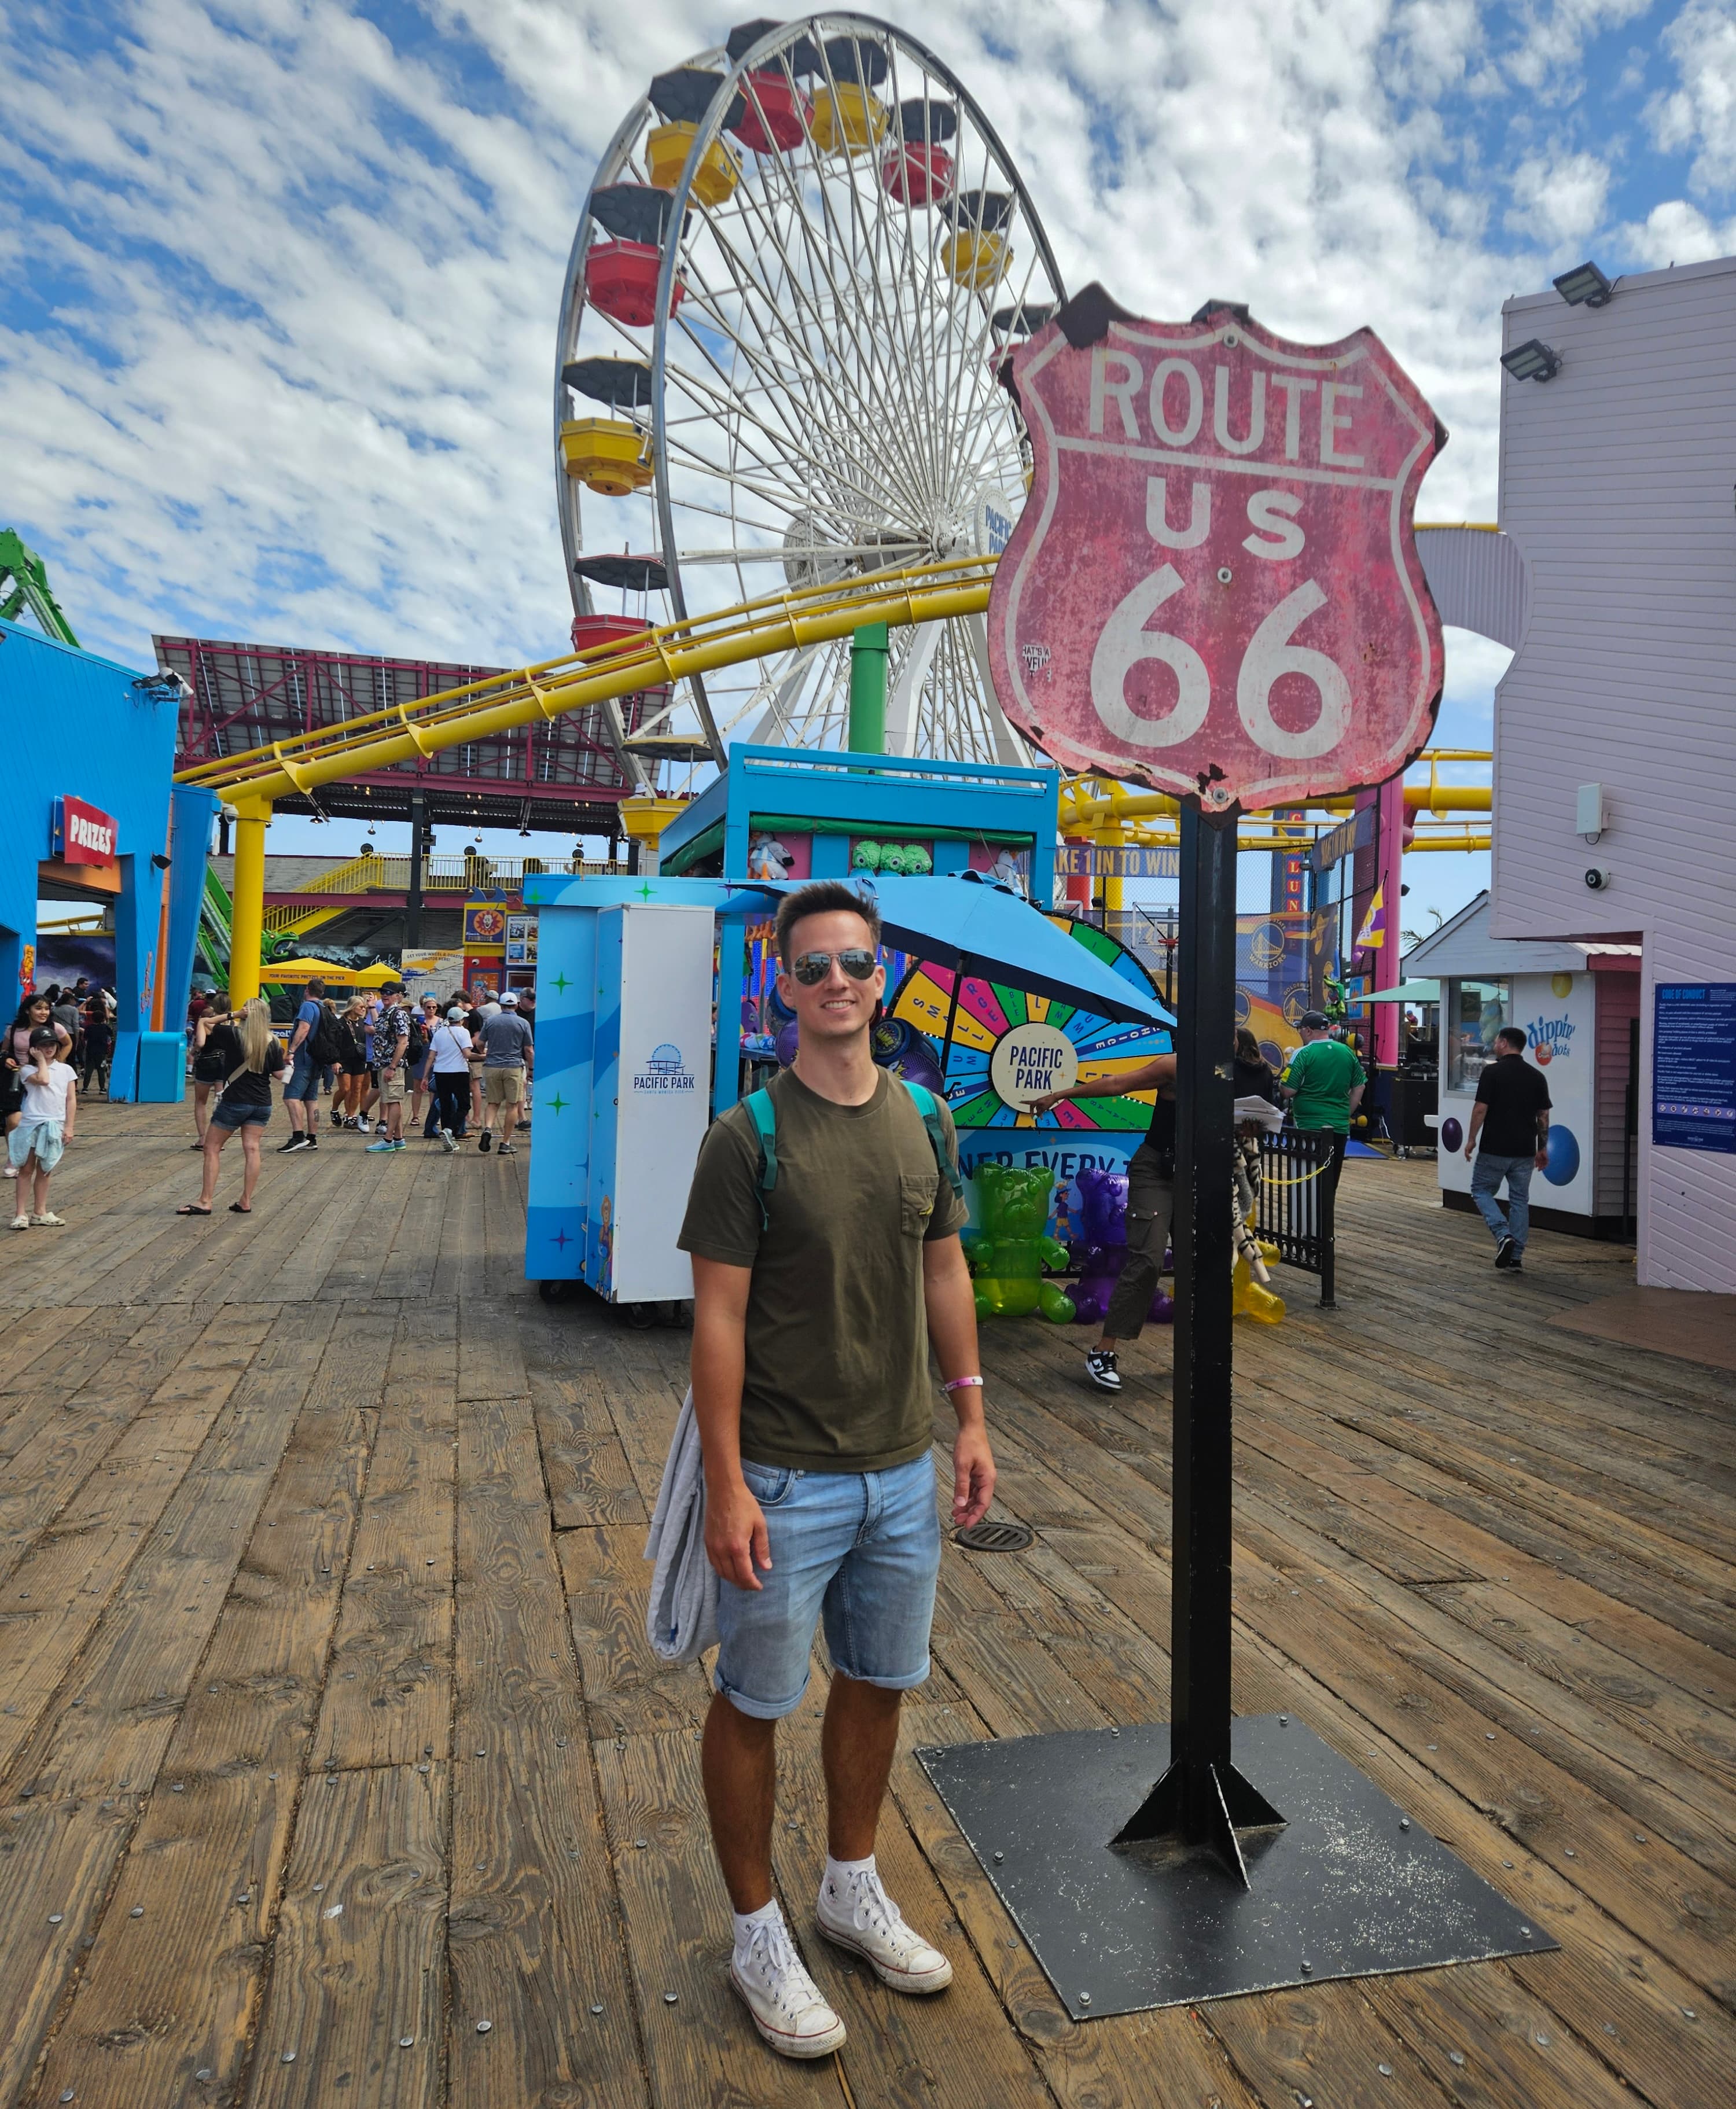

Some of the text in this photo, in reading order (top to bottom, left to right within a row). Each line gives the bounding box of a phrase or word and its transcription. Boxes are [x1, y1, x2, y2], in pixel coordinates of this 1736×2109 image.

[1089, 345, 1366, 469] ROUTE
[985, 504, 1012, 541] PACIFIC
[989, 532, 1006, 554] PAR
[1090, 562, 1352, 760] 66
[70, 814, 112, 855] PRIZES
[1084, 849, 1091, 874] 1
[1097, 849, 1115, 874] IN
[1120, 851, 1141, 875] TO
[1146, 851, 1180, 877] WIN
[1249, 953, 1287, 969] WARRIORS
[1662, 989, 1675, 1000] CODE
[1675, 989, 1682, 1000] OF
[1682, 989, 1706, 1000] CONDUCT
[1527, 1013, 1576, 1050] dippin'
[1010, 1046, 1063, 1069] PACIFIC
[1552, 1043, 1571, 1058] dots
[634, 1076, 695, 1089] PACIFIC PARK
[1016, 1068, 1053, 1090] PARK
